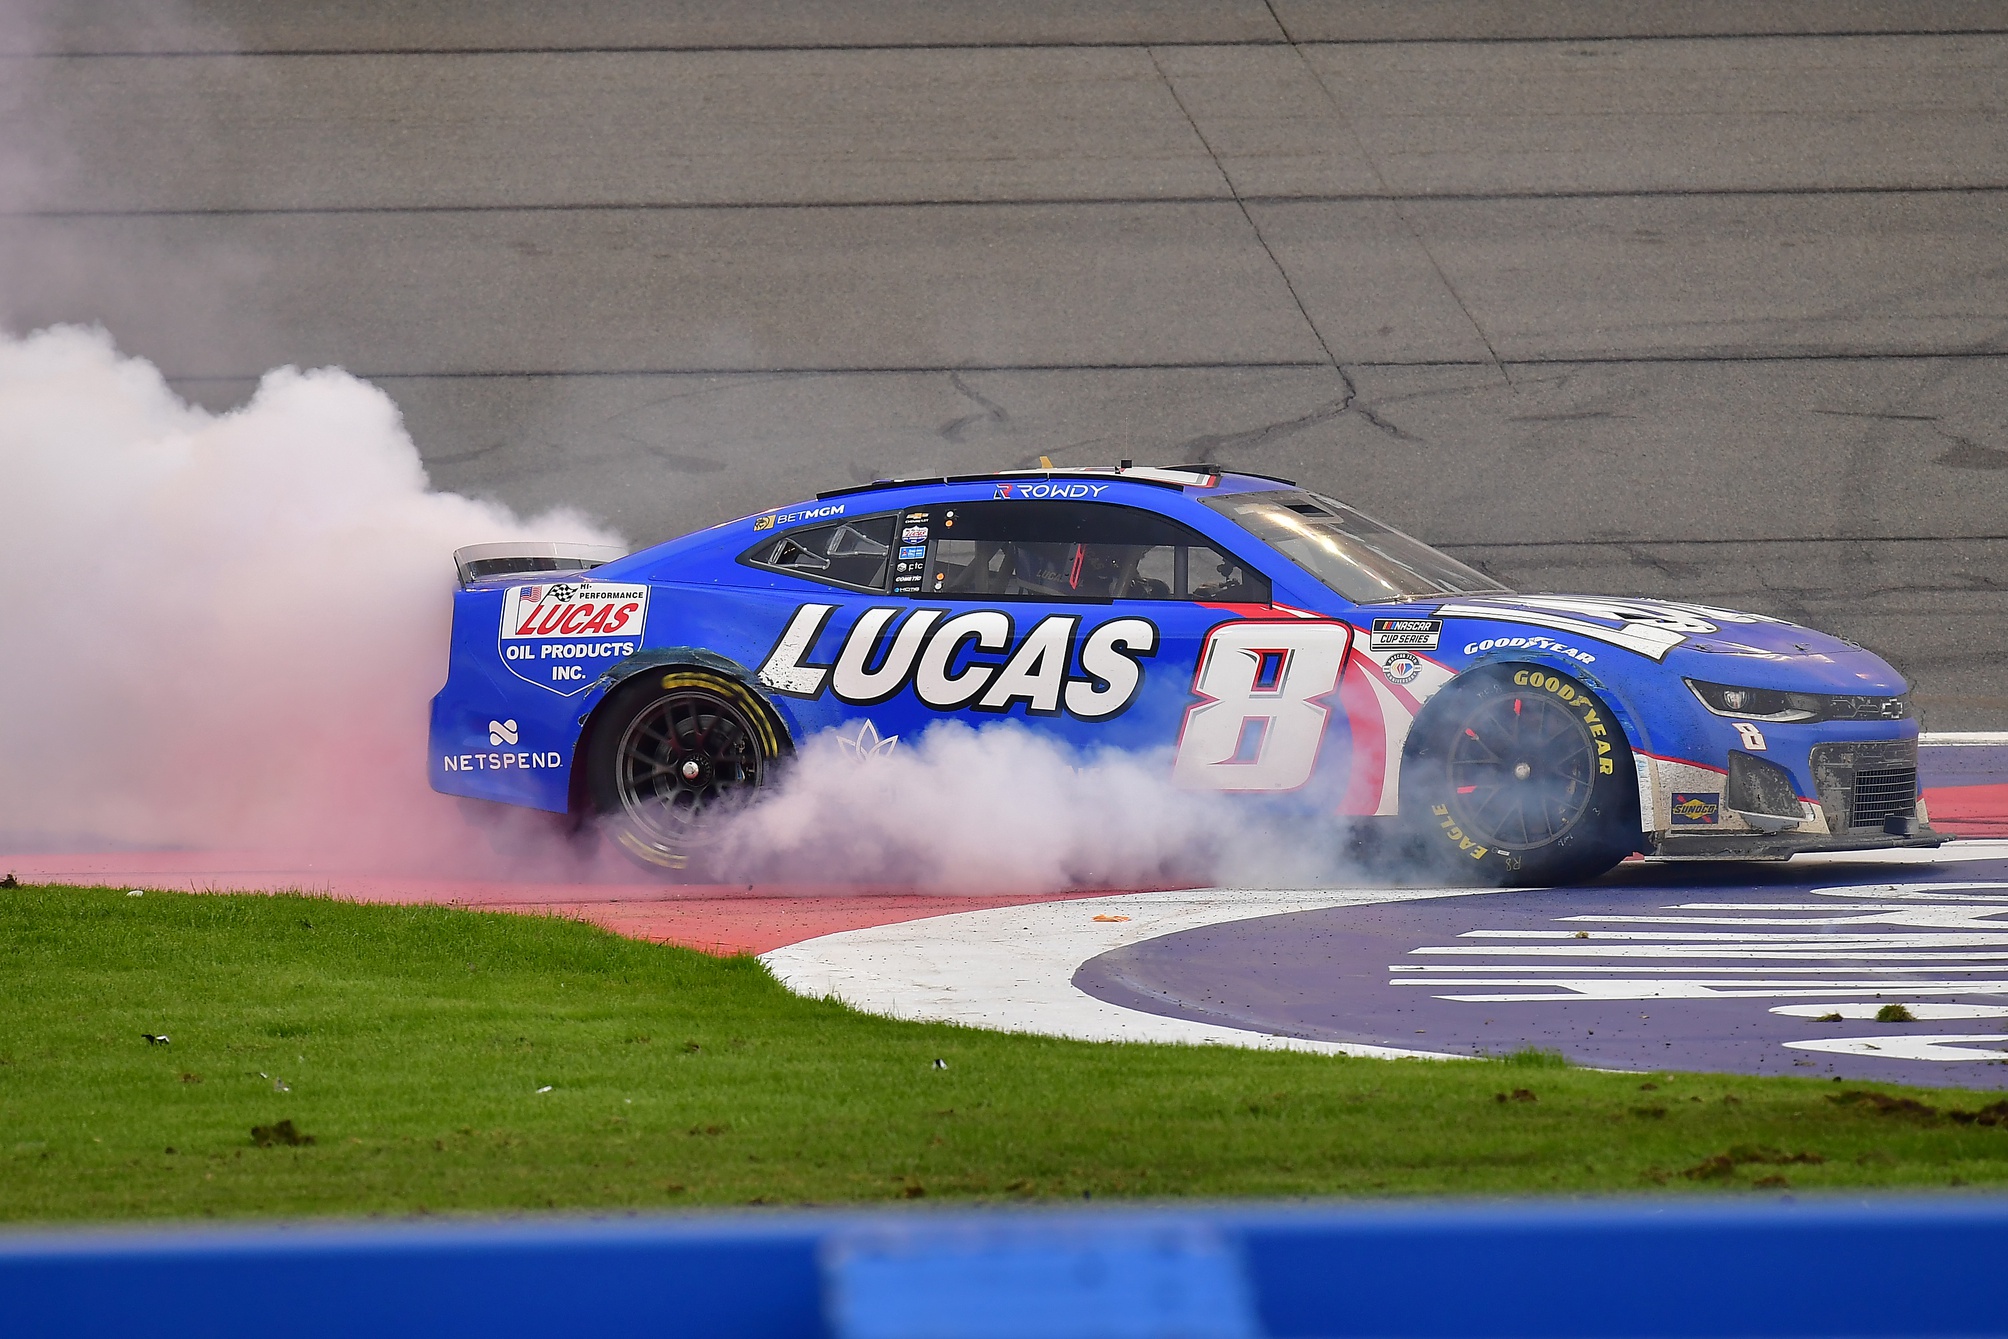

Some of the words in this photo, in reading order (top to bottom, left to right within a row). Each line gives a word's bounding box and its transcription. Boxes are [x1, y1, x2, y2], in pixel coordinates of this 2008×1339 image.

[1017, 484, 1109, 498] ROWDY
[777, 505, 845, 524] BETMGM
[579, 591, 644, 600] PERFORMANCE
[515, 603, 639, 635] LUCAS
[1393, 621, 1432, 631] NASCAR
[1380, 634, 1399, 644] CUP
[1399, 634, 1430, 644] SERIES
[506, 645, 535, 660] OIL
[541, 642, 634, 660] PRODUCTS
[1463, 636, 1596, 665] GOODYEAR
[758, 603, 1157, 719] LUCAS
[552, 666, 586, 681] INC.
[1174, 619, 1352, 791] 8
[1513, 670, 1614, 776] GOODYEAR
[1731, 722, 1767, 751] 8
[444, 751, 562, 771] NETSPEND
[1674, 805, 1716, 814] SUNOCO
[1432, 803, 1488, 860] EAGLE
